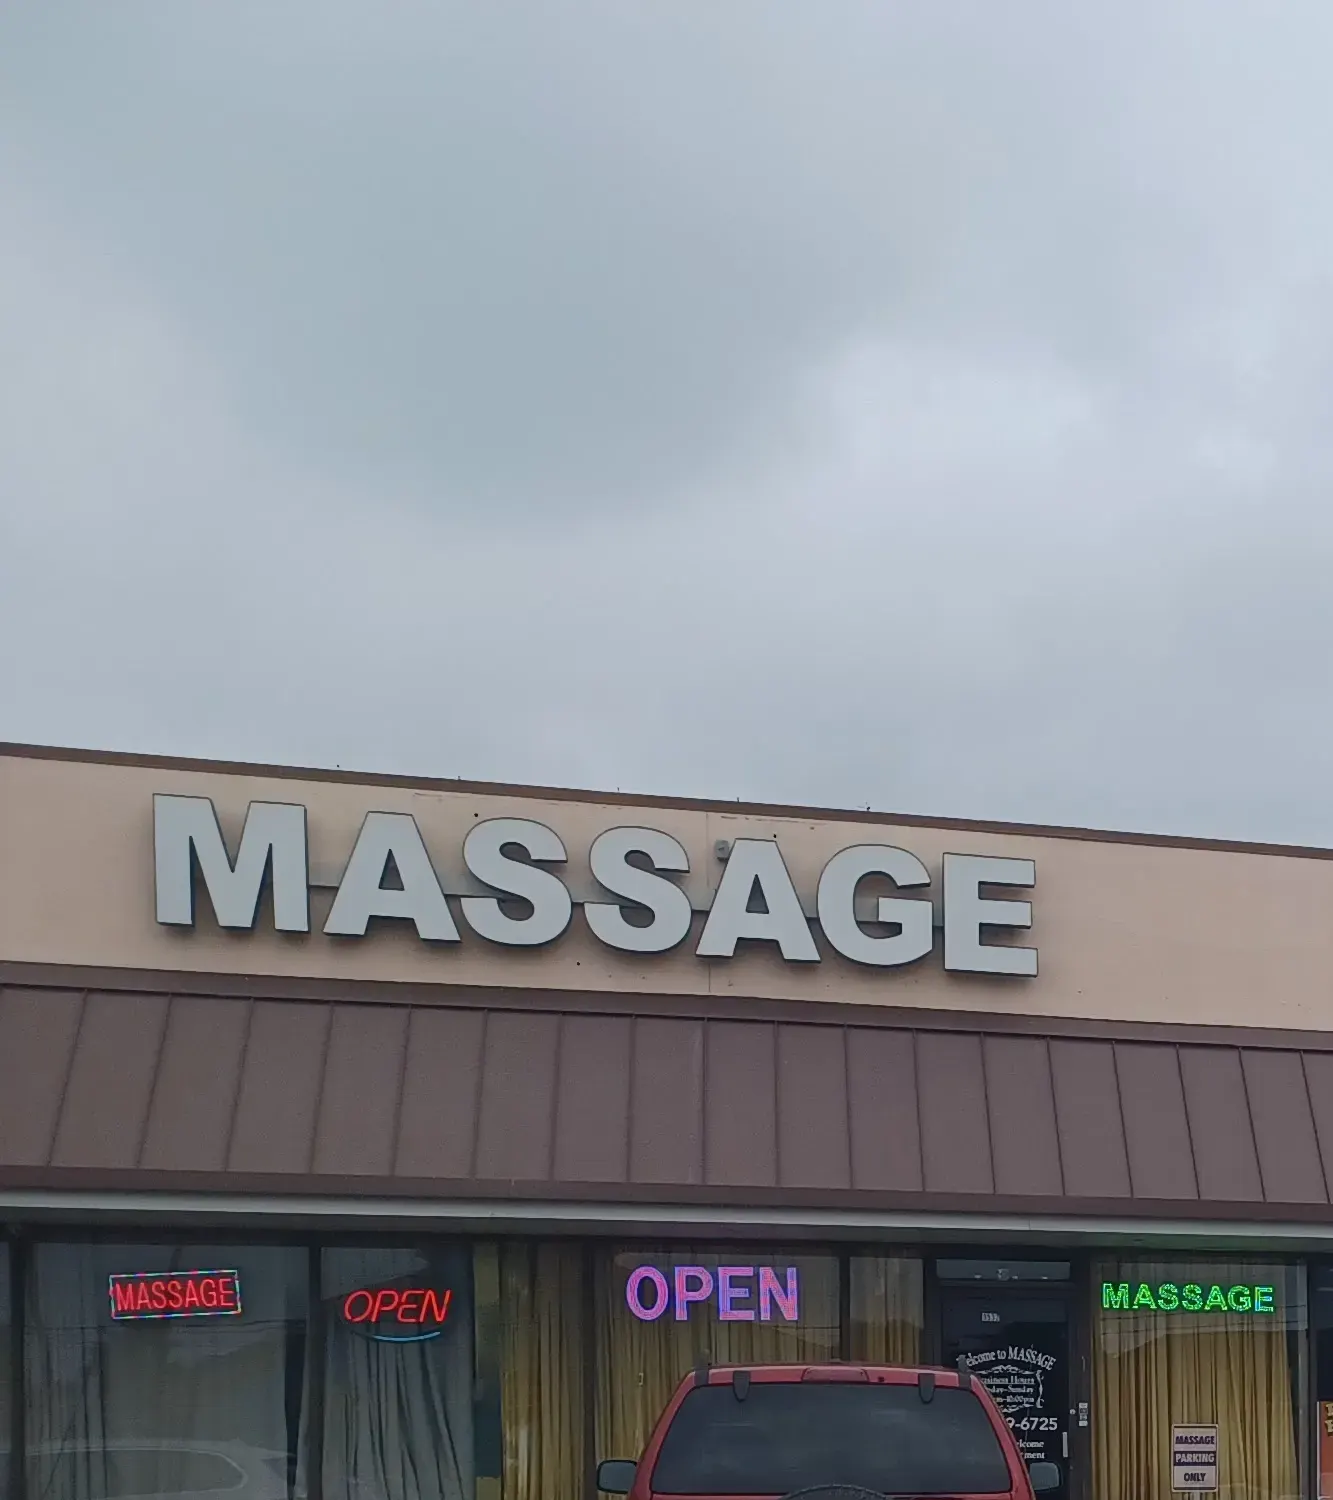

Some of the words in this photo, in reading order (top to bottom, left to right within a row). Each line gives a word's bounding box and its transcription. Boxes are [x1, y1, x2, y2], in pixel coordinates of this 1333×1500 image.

[152, 793, 1038, 977] MASSAGE
[114, 1278, 235, 1311] MASSAGE
[343, 1289, 452, 1324] OPEN
[626, 1264, 799, 1322] OPEN
[1101, 1283, 1275, 1313] MASSAGE
[957, 1350, 996, 1367] elcome
[997, 1349, 1007, 1360] to
[1008, 1345, 1056, 1371] MASSAGE
[1005, 1417, 1059, 1431] 9-6725
[1175, 1435, 1215, 1445] MASSAGE
[1175, 1453, 1215, 1463] PARKING
[1183, 1472, 1206, 1482] ONLY
